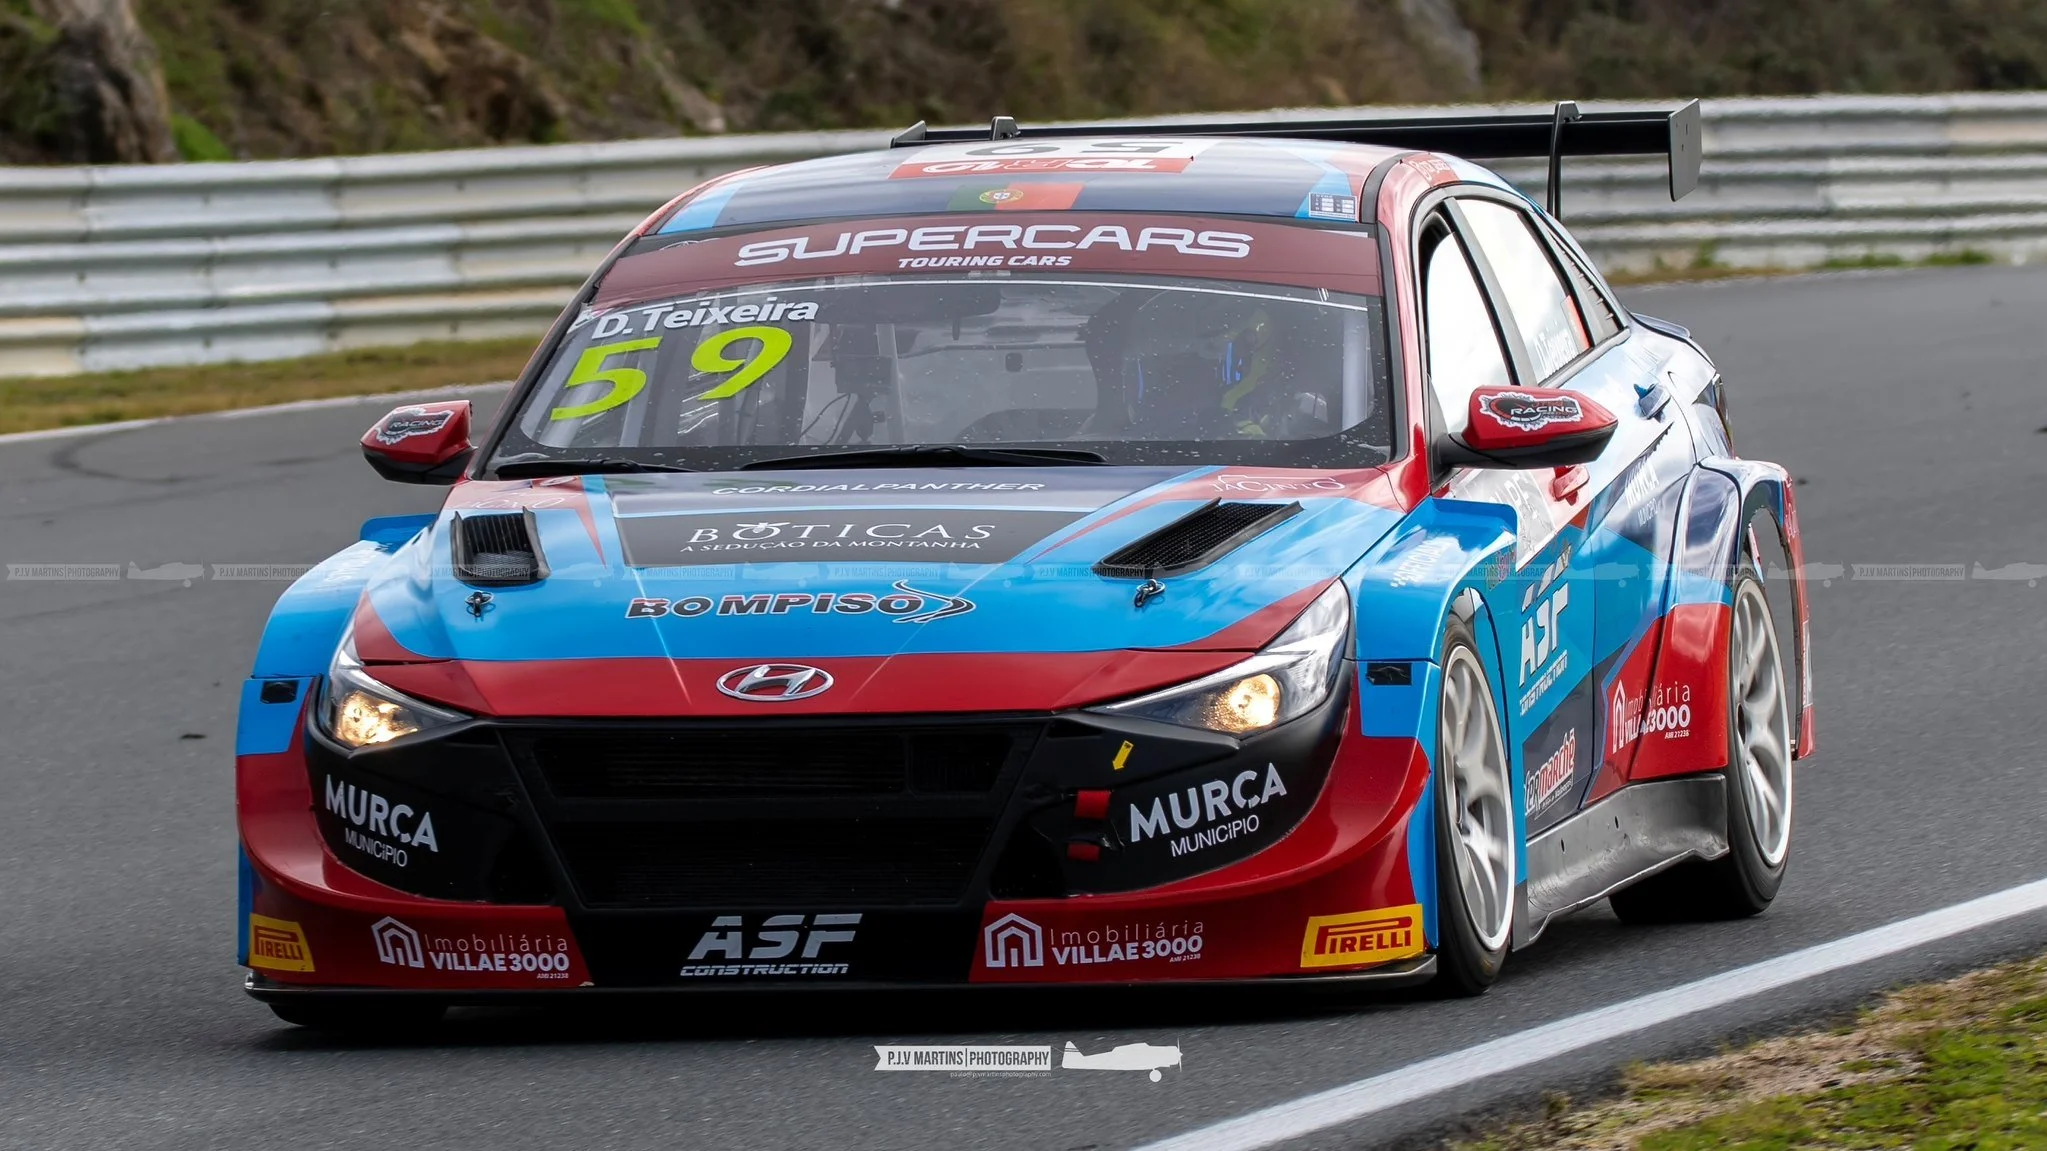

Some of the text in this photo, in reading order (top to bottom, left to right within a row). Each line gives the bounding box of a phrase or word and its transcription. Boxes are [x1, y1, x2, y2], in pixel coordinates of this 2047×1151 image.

[734, 224, 1254, 267] SUPERCARS
[898, 255, 1072, 269] TOURING CARS
[644, 297, 819, 332] Teixeira
[551, 326, 793, 421] 59
[1511, 405, 1578, 416] RACING
[388, 419, 444, 429] RACING
[712, 482, 1046, 496] CORDIALPANTHER
[812, 540, 843, 548] DA
[848, 540, 981, 549] MONTANHA
[624, 592, 925, 620] BOMPISO
[254, 925, 304, 961] PIRELLI
[425, 933, 568, 953] Imobiliária
[687, 913, 863, 960] ASF
[1050, 920, 1204, 946] Imobiliária
[1313, 916, 1413, 955] PIRELLI
[680, 963, 849, 977] CONSTRUCTION
